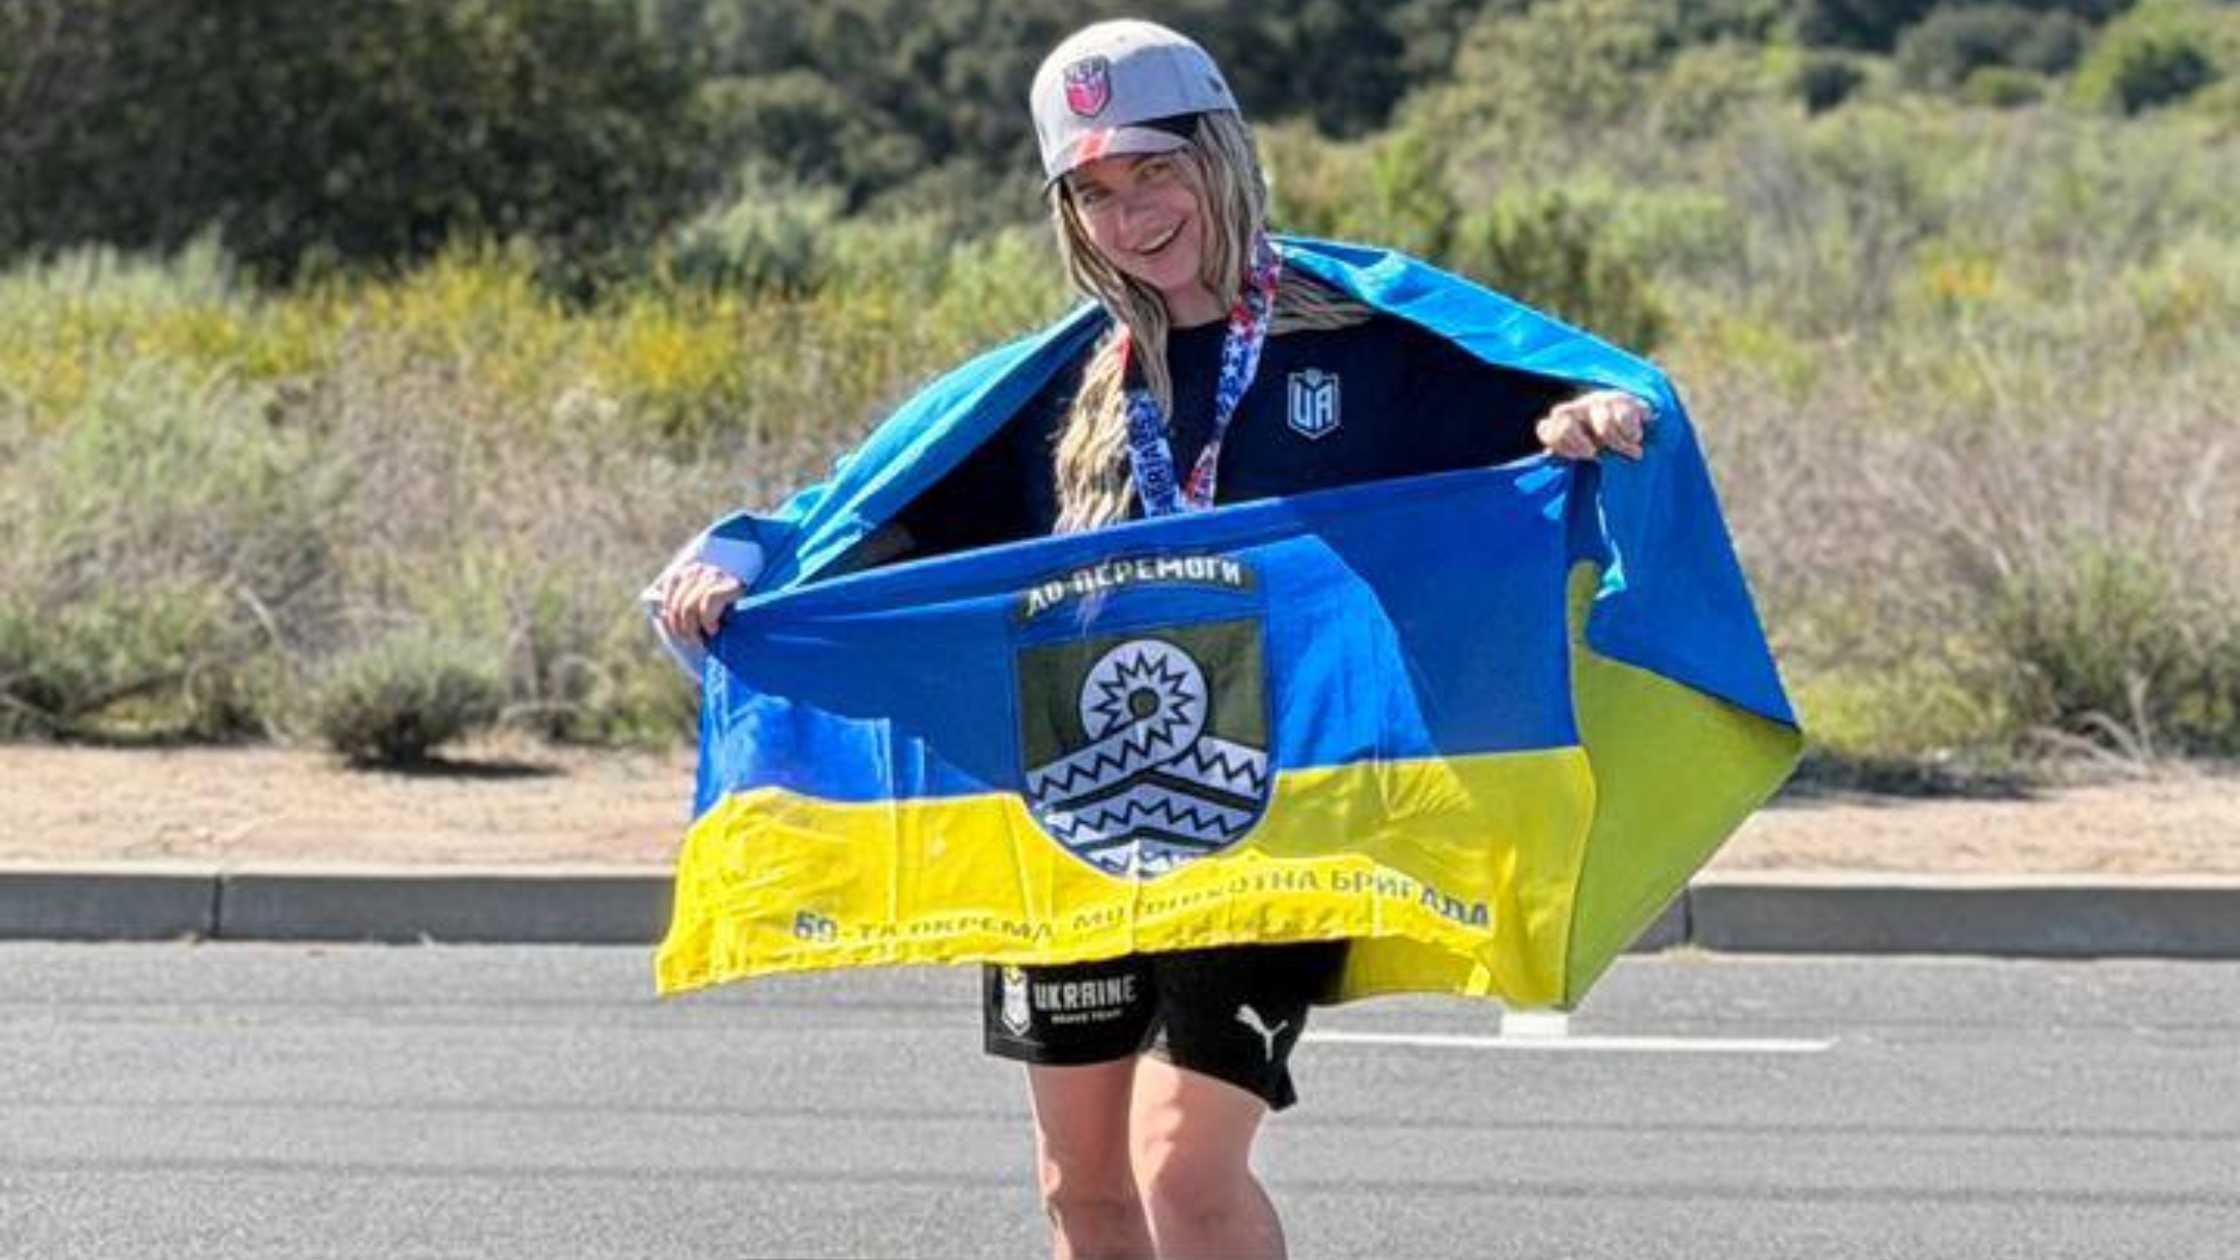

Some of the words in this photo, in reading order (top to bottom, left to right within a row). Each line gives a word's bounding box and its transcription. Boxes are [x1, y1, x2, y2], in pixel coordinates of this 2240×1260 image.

[1072, 556, 1242, 594] ПЕРЕМОГИ
[1330, 869, 1490, 927] БРИГАДА
[1032, 974, 1137, 1011] UKRAINE
